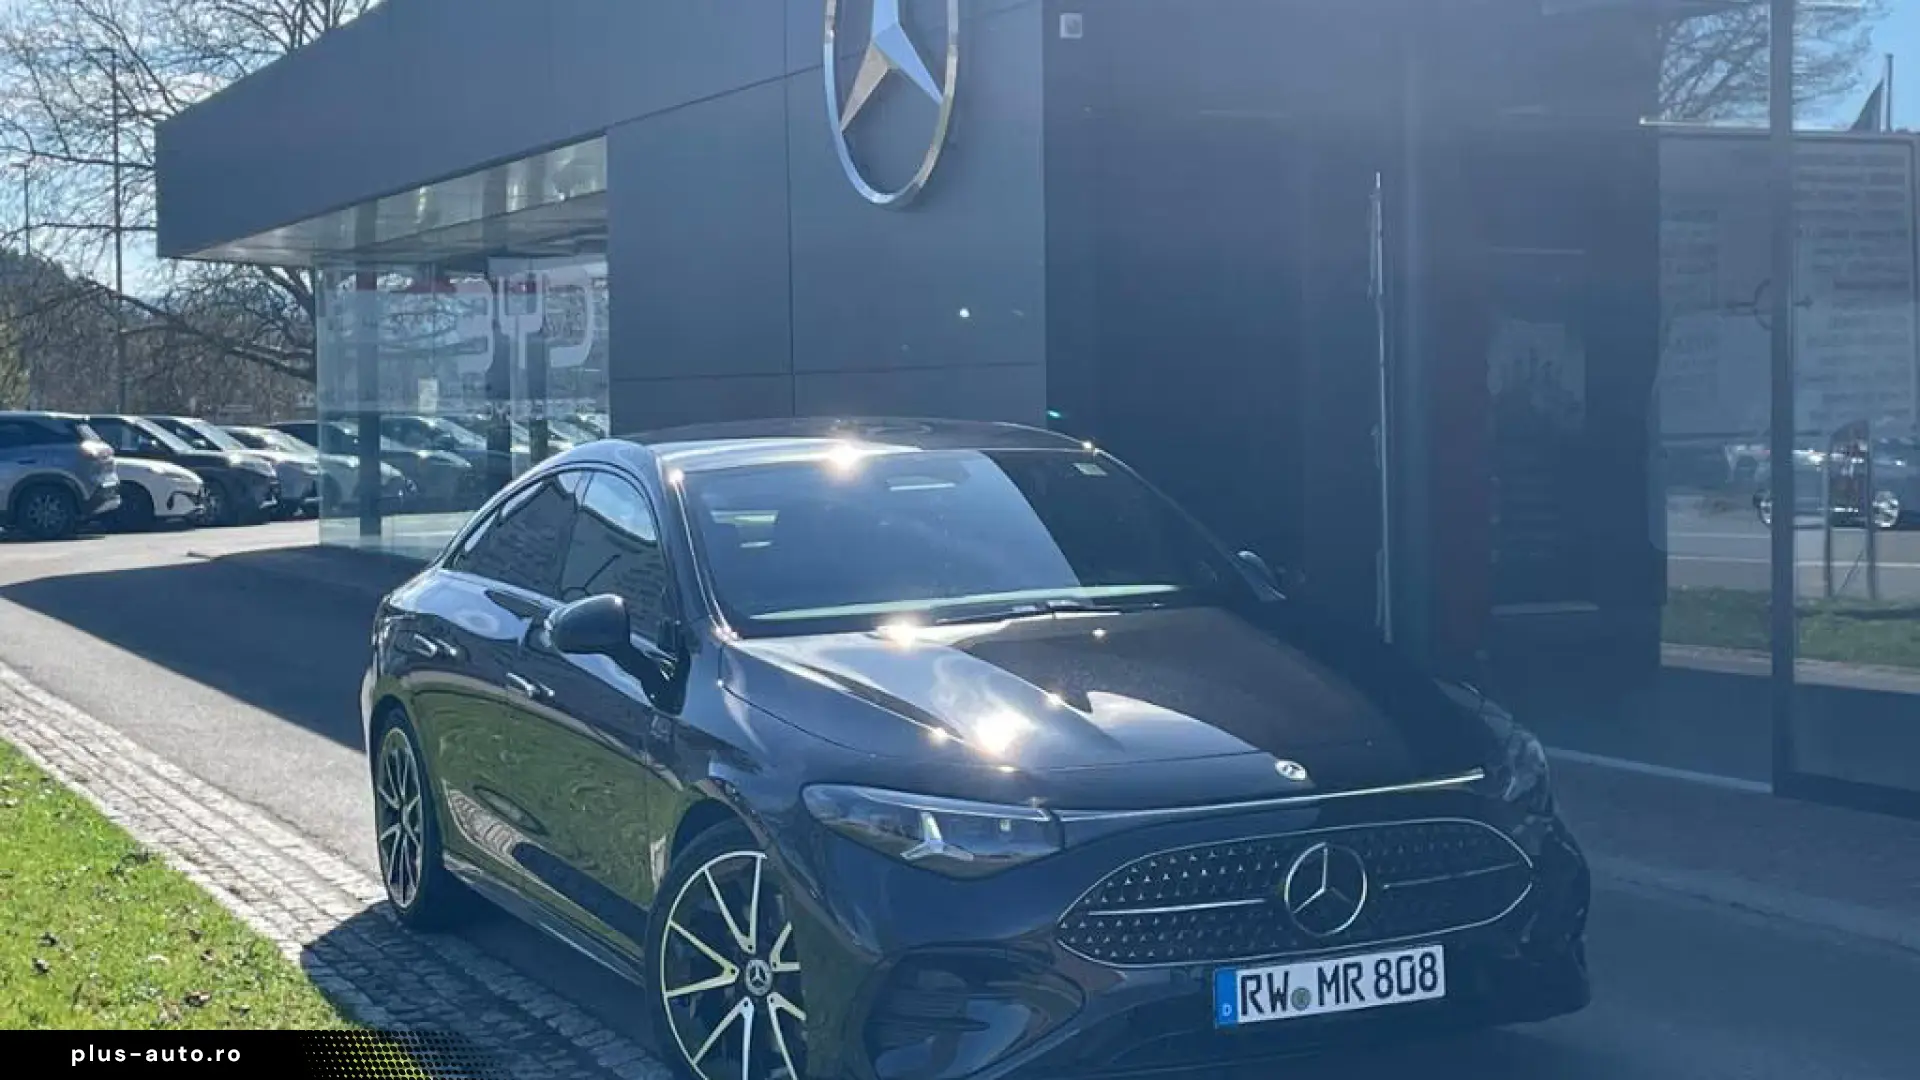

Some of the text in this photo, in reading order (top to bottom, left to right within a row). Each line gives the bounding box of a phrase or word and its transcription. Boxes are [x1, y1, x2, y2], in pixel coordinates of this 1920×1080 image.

[1240, 952, 1438, 1016] RW MR 808
